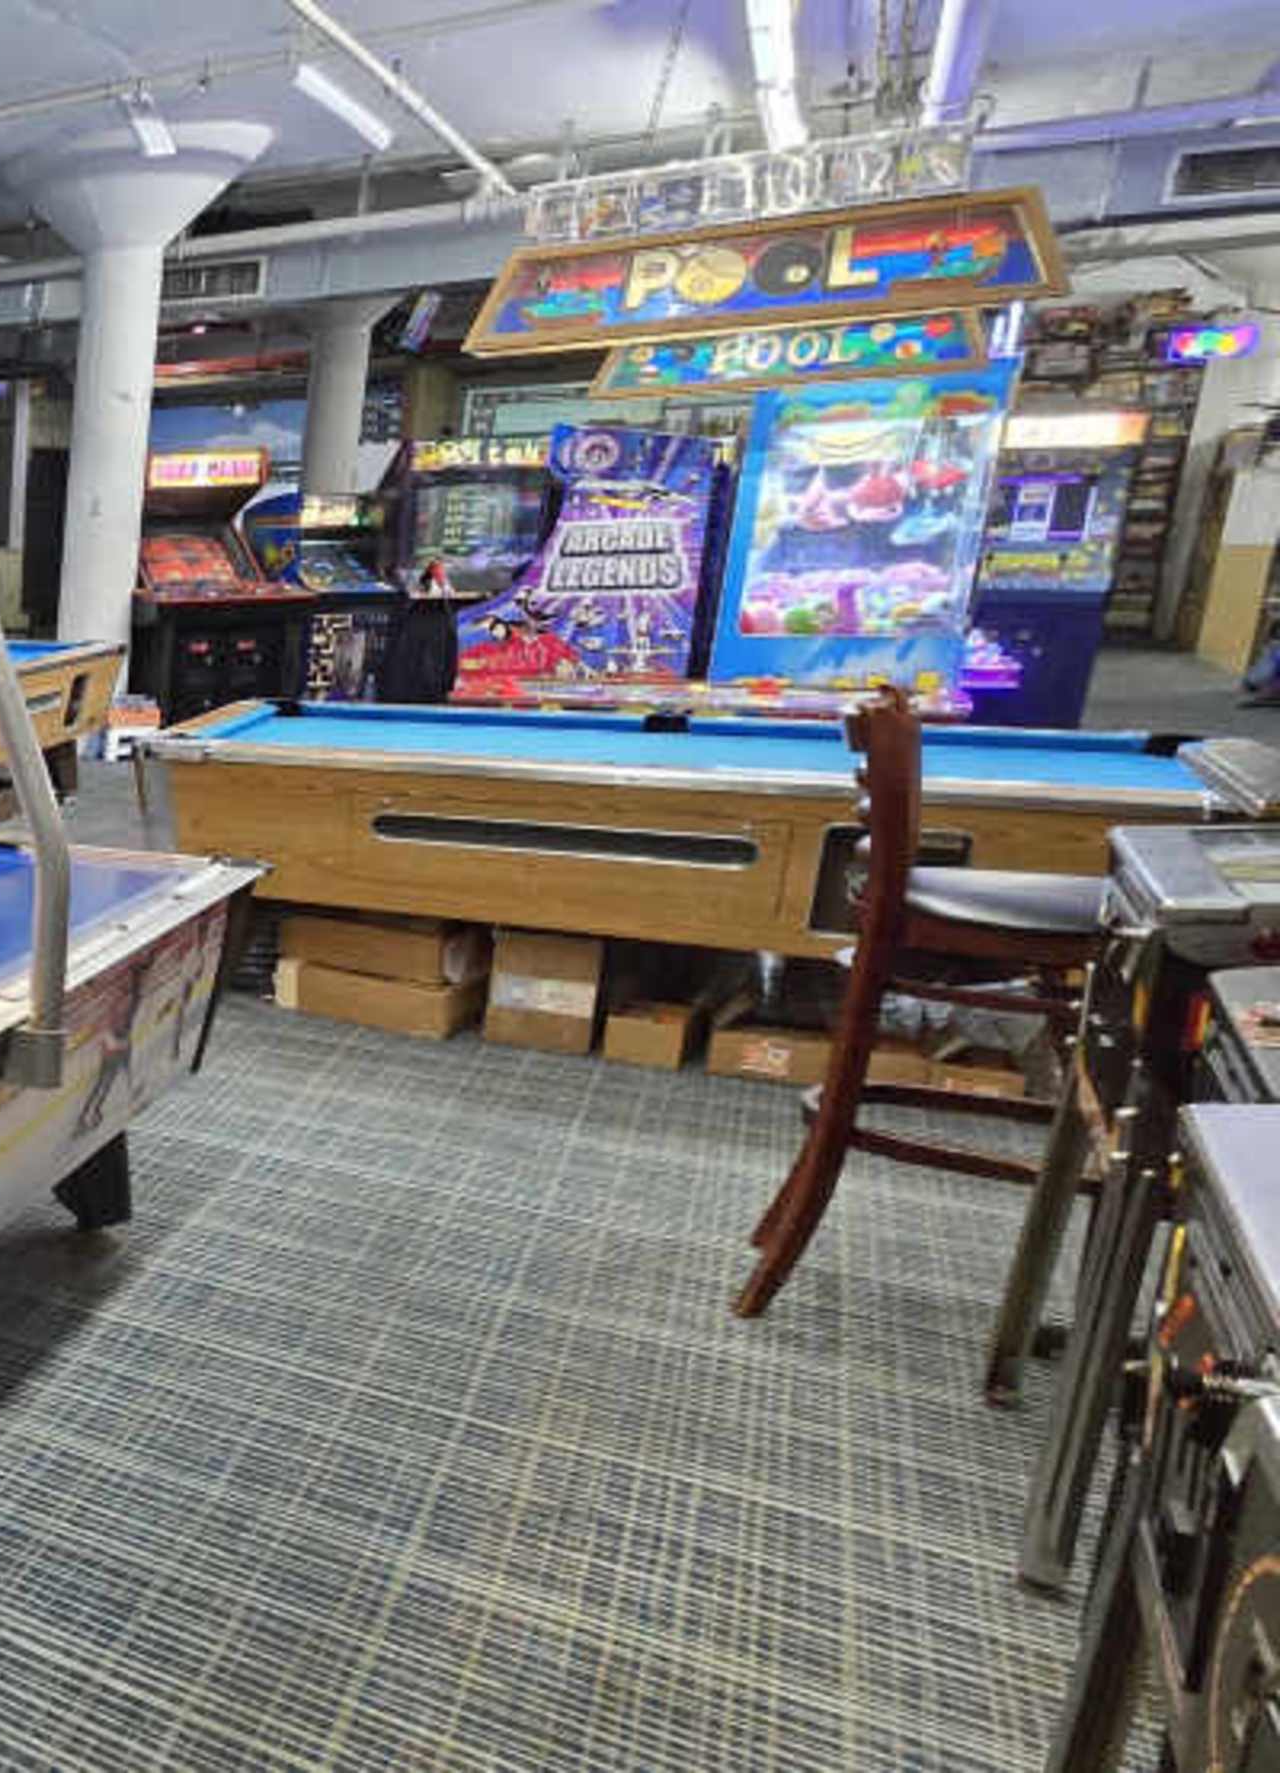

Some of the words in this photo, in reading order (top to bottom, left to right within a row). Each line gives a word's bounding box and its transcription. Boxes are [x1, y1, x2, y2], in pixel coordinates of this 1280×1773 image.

[624, 226, 880, 309] POOL
[708, 324, 861, 374] POOL
[562, 522, 675, 555] ARCADE
[549, 553, 683, 590] LEGENDS
